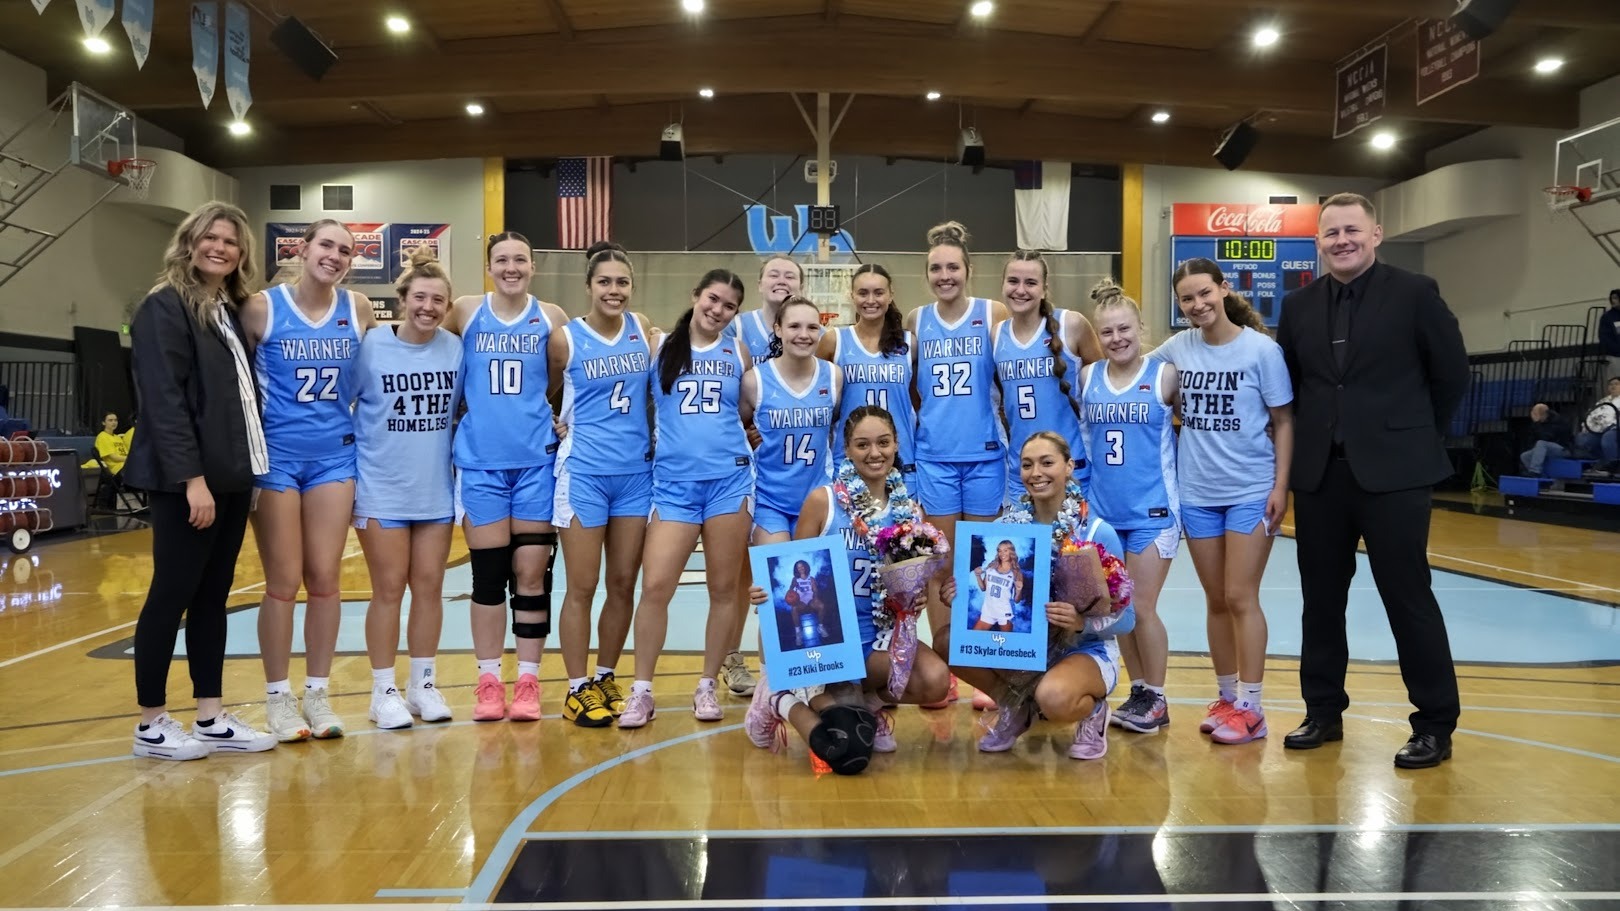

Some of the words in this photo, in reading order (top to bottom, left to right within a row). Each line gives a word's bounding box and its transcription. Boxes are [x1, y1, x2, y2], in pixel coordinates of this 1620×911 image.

[1225, 240, 1273, 258] 10:00
[1281, 261, 1315, 270] GUEST
[280, 338, 352, 361] WARNER
[475, 332, 540, 354] WARNER
[922, 336, 983, 360] WARNER
[489, 359, 523, 395] 10
[582, 352, 648, 380] WARNER
[844, 363, 905, 384] WARNER
[998, 355, 1055, 382] WARNER
[295, 366, 341, 403] 22
[381, 370, 457, 393] HOOPIN'
[931, 361, 972, 397] 32
[393, 395, 406, 416] 4
[411, 393, 451, 416] THE
[610, 380, 631, 414] 4
[677, 380, 722, 415] 25
[1016, 384, 1036, 420] 5
[1191, 393, 1235, 415] THE
[387, 416, 449, 432] HOMELES
[768, 406, 832, 430] WARNER
[1087, 402, 1150, 424] WARNER
[783, 433, 816, 466] 14
[1105, 430, 1124, 466] 3
[960, 645, 972, 654] #13
[974, 645, 996, 657] Skylar
[998, 647, 1036, 659] Groesbeck
[788, 665, 802, 677] #23
[803, 663, 817, 675] Kiki
[818, 661, 844, 673] Brooks
